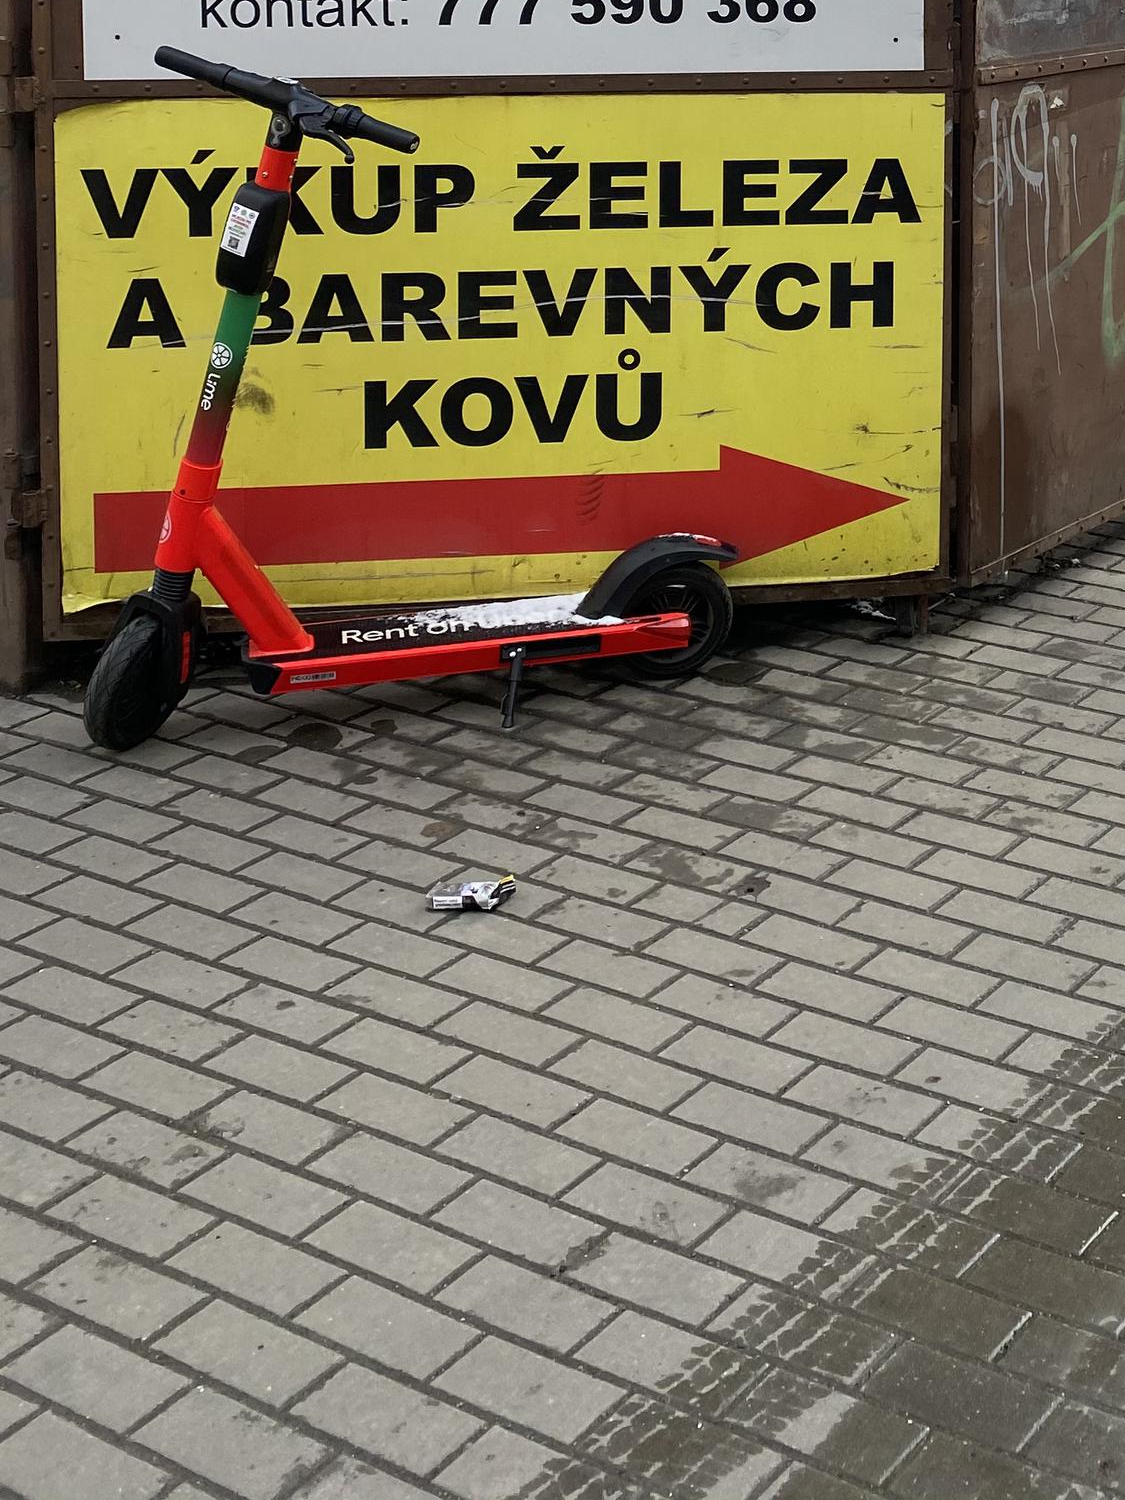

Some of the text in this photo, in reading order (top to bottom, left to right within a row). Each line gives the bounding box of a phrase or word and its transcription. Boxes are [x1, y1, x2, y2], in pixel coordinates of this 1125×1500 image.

[513, 145, 922, 231] ŽELEZA
[106, 247, 894, 349] A BAREVNÝCH
[201, 373, 221, 411] Lime
[364, 348, 662, 449] KOVŮ
[341, 624, 419, 645] Rent
